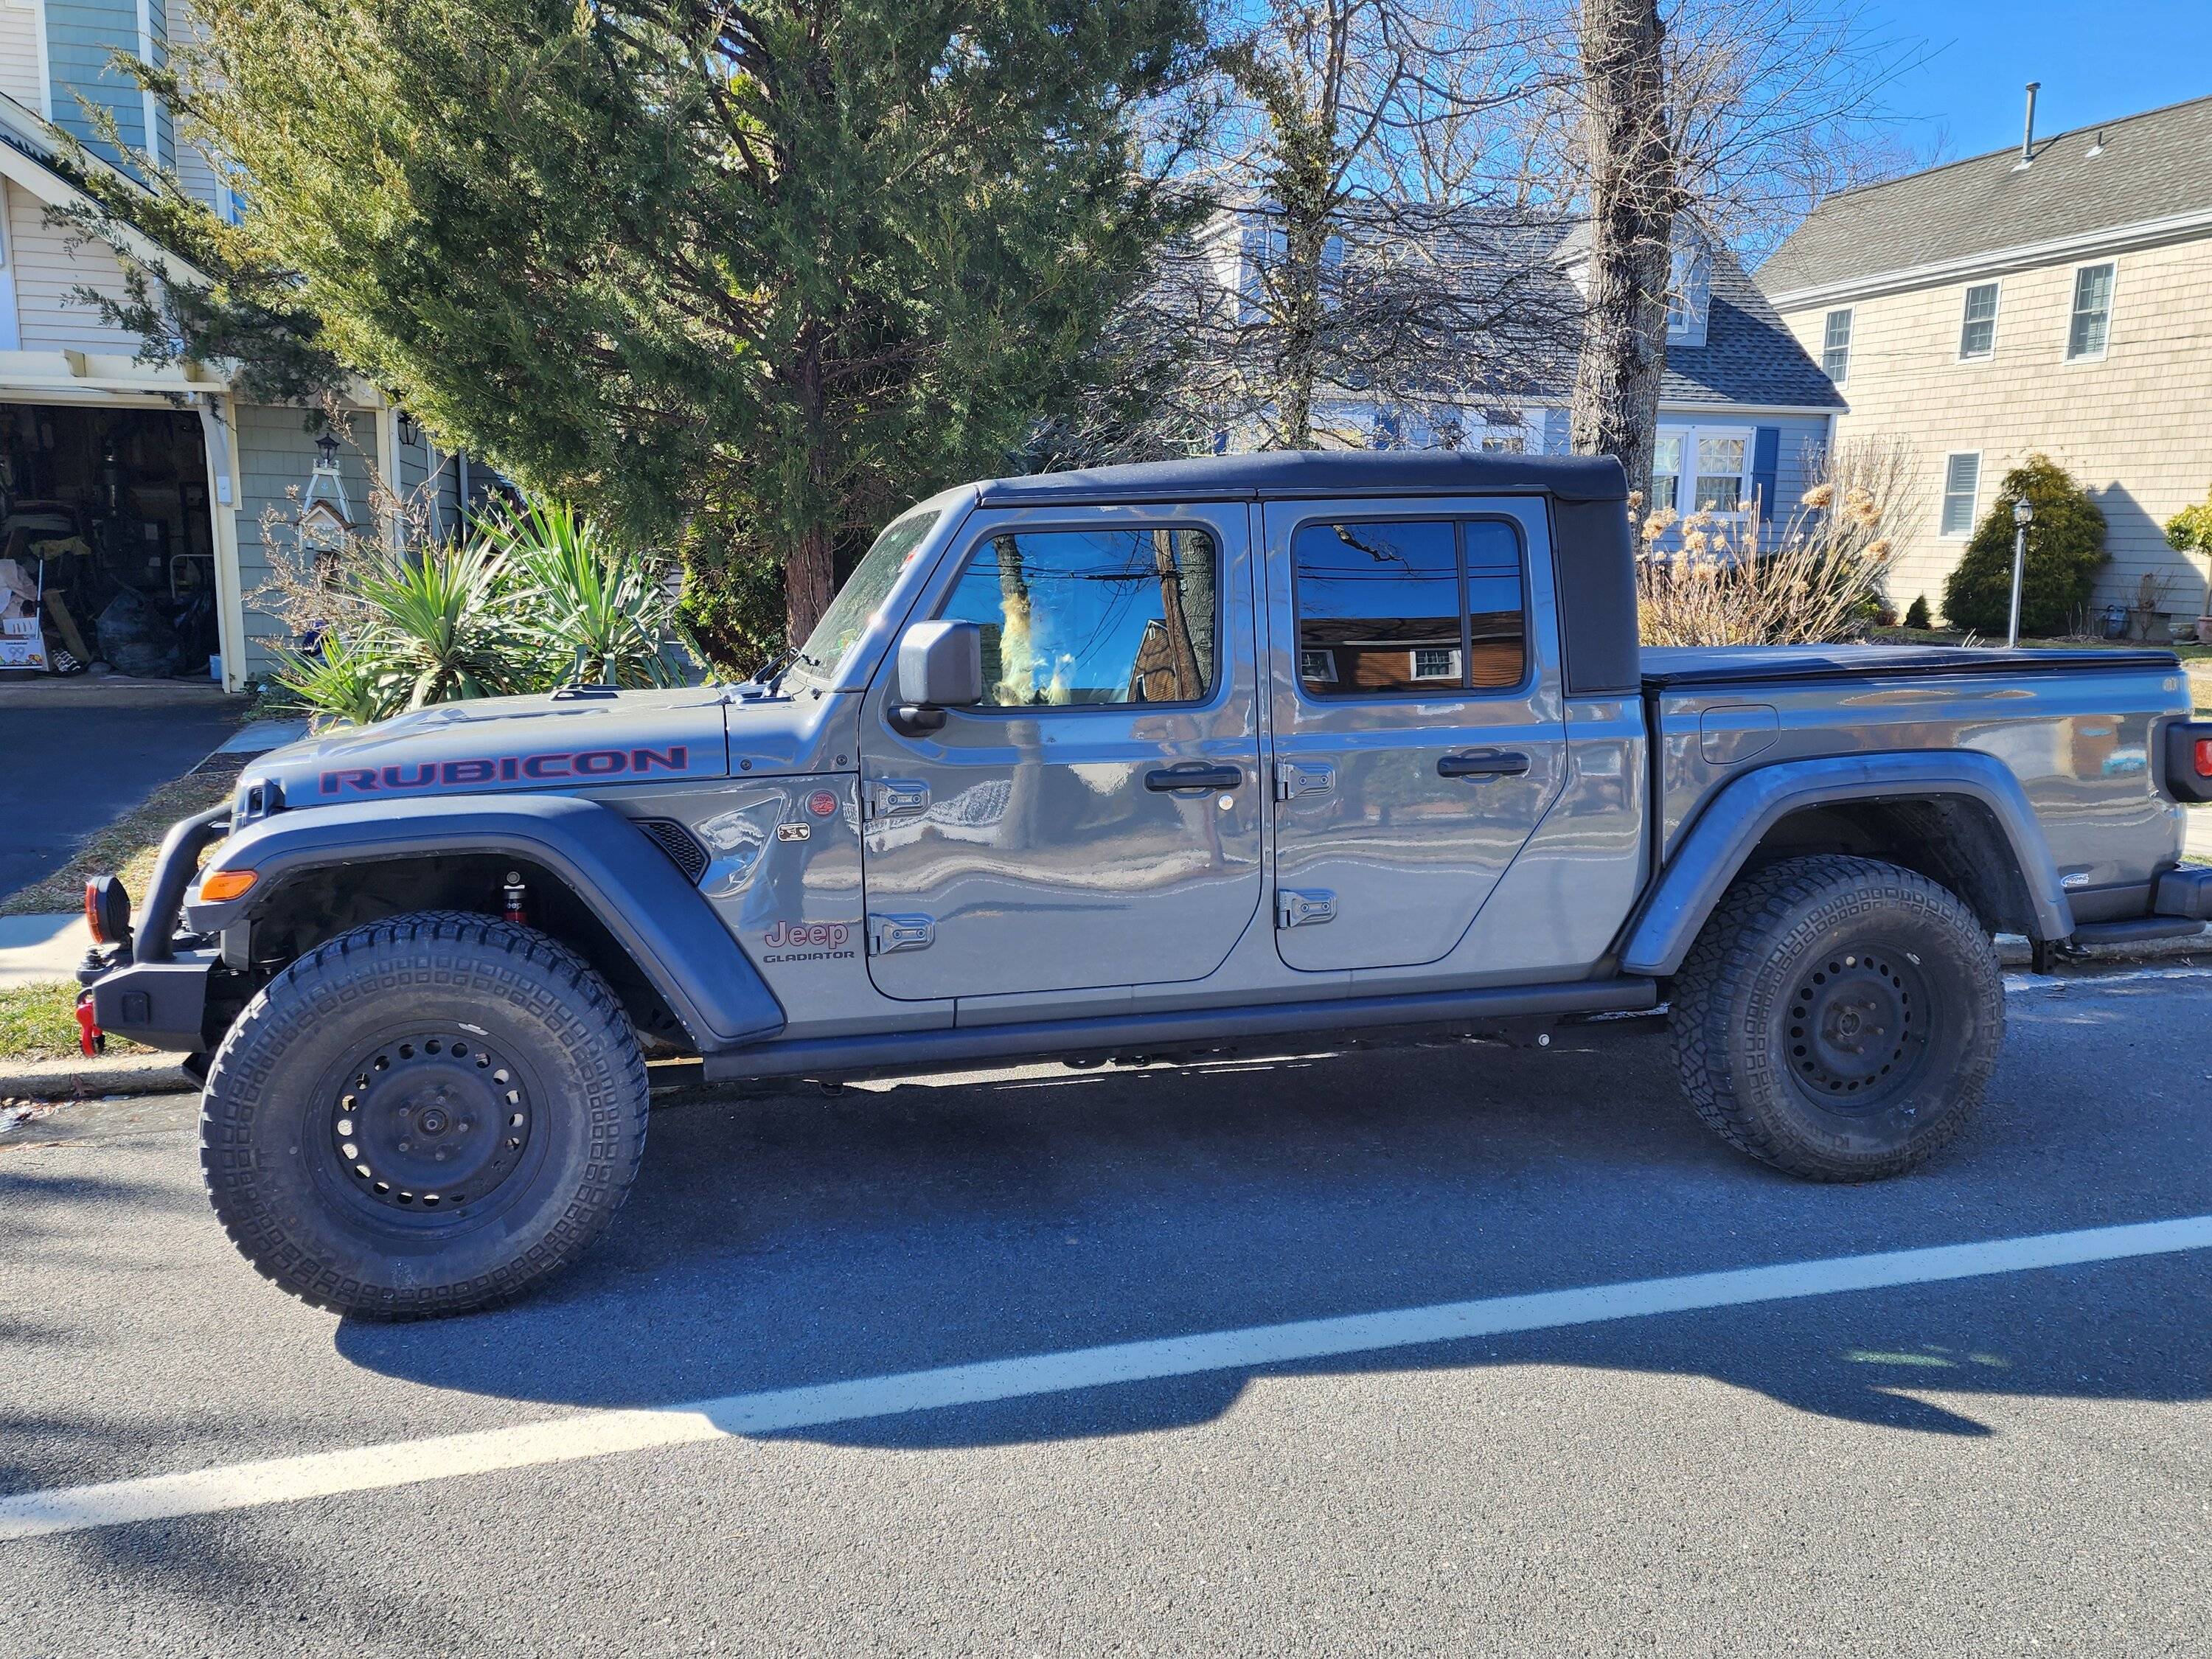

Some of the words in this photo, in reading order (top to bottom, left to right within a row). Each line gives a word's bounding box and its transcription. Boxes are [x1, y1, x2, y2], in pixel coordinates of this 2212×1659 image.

[319, 746, 688, 795] RUBICON
[765, 921, 848, 949] Jeep
[763, 950, 855, 963] GLADIATOR
